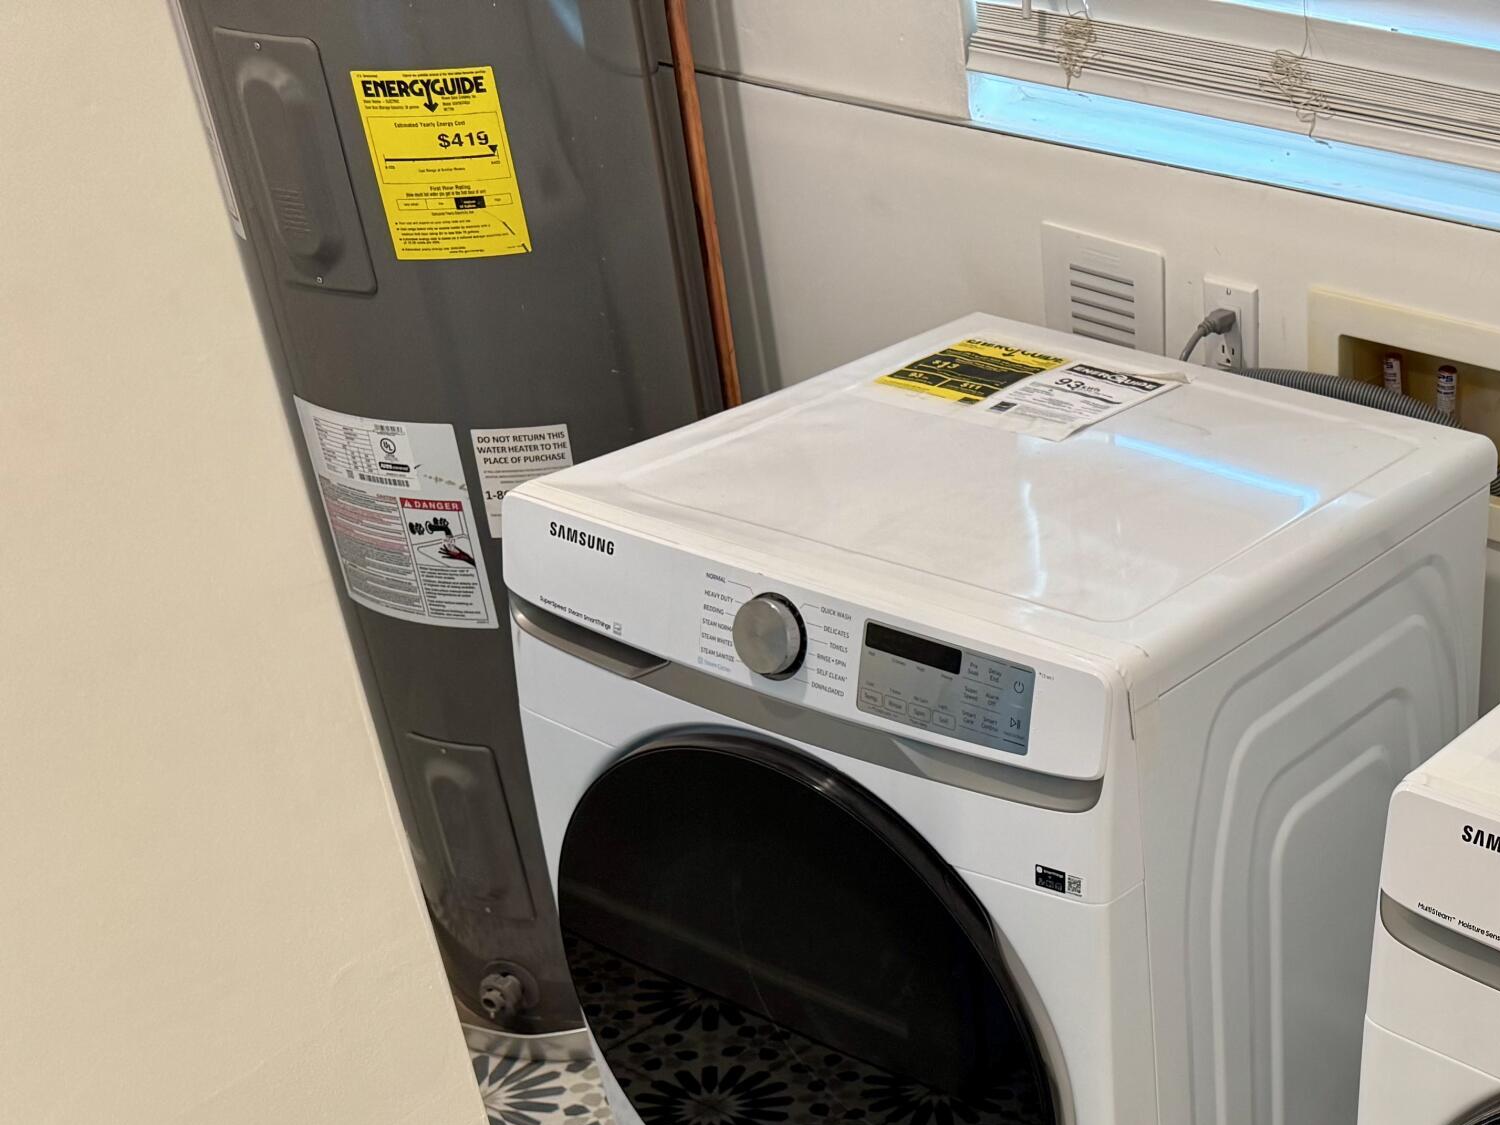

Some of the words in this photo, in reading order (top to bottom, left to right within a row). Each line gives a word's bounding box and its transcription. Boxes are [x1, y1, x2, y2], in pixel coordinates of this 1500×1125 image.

[361, 76, 487, 99] ENERGYGUIDE
[438, 131, 489, 149] $419
[1055, 378, 1085, 391] 93
[492, 435, 510, 443] NOT
[512, 434, 545, 442] RETURN
[547, 431, 565, 439] THIS
[476, 446, 507, 454] WATER
[508, 444, 540, 453] HEATER
[540, 443, 552, 451] TO
[483, 456, 510, 464] PLACE
[523, 453, 566, 463] PURCHASE
[414, 501, 459, 510] DANGER
[550, 521, 615, 555] SAMSUNG
[706, 572, 726, 584] NORMAL
[704, 589, 720, 599] HEAVY
[720, 593, 734, 603] DUTY
[703, 603, 725, 615] BEDDING
[820, 606, 836, 616] QUICK
[836, 611, 852, 621] WASH
[702, 617, 717, 627] STEAM
[701, 632, 716, 641] STEAM
[823, 625, 850, 639] DELICATES
[700, 646, 716, 655] STEAM
[816, 667, 828, 676] SELF
[1458, 919, 1485, 935] Moisture
